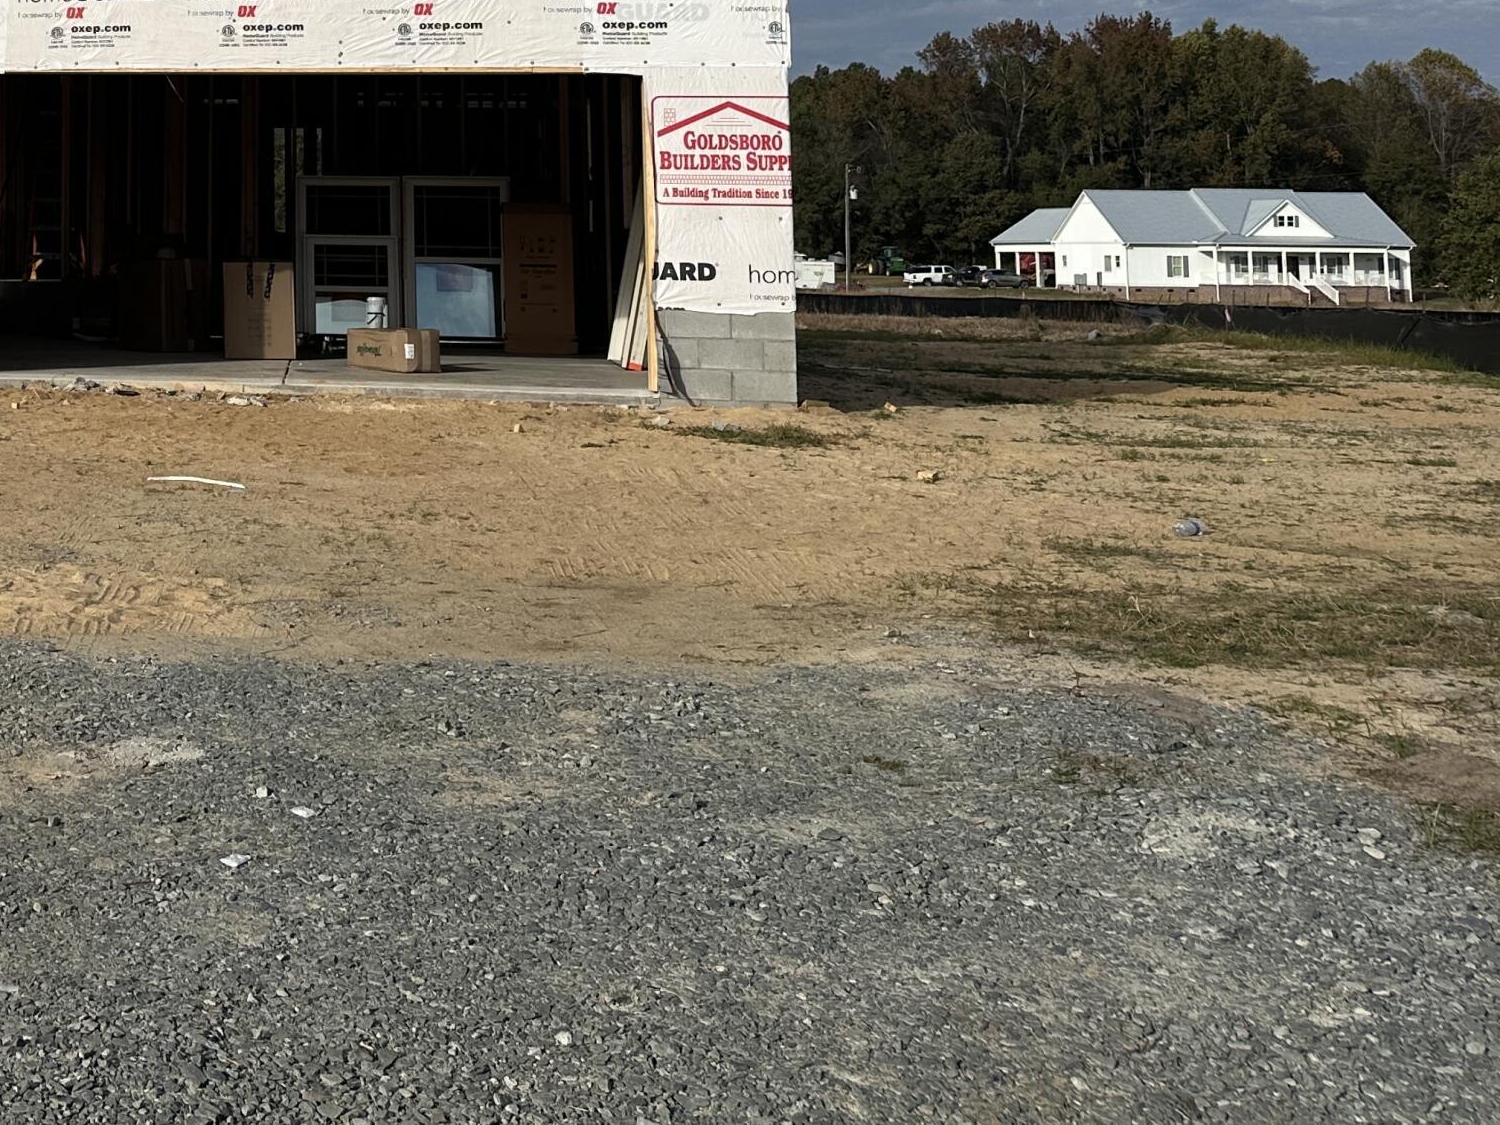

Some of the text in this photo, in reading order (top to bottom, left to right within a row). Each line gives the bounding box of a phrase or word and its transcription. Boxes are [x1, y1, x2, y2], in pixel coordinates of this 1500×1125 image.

[66, 7, 85, 19] OX
[238, 5, 256, 17] OX
[414, 3, 434, 15] OX
[596, 2, 617, 15] OX
[71, 25, 131, 34] oxep.com
[243, 23, 304, 33] oxep.com
[419, 21, 483, 31] oxep.com
[602, 21, 668, 31] oxep.com
[684, 131, 782, 151] GOLDSBORO
[660, 151, 742, 171] BUILDERS
[663, 188, 670, 197] A
[672, 187, 710, 201] Building
[712, 189, 754, 199] Tradition
[756, 189, 780, 199] Since
